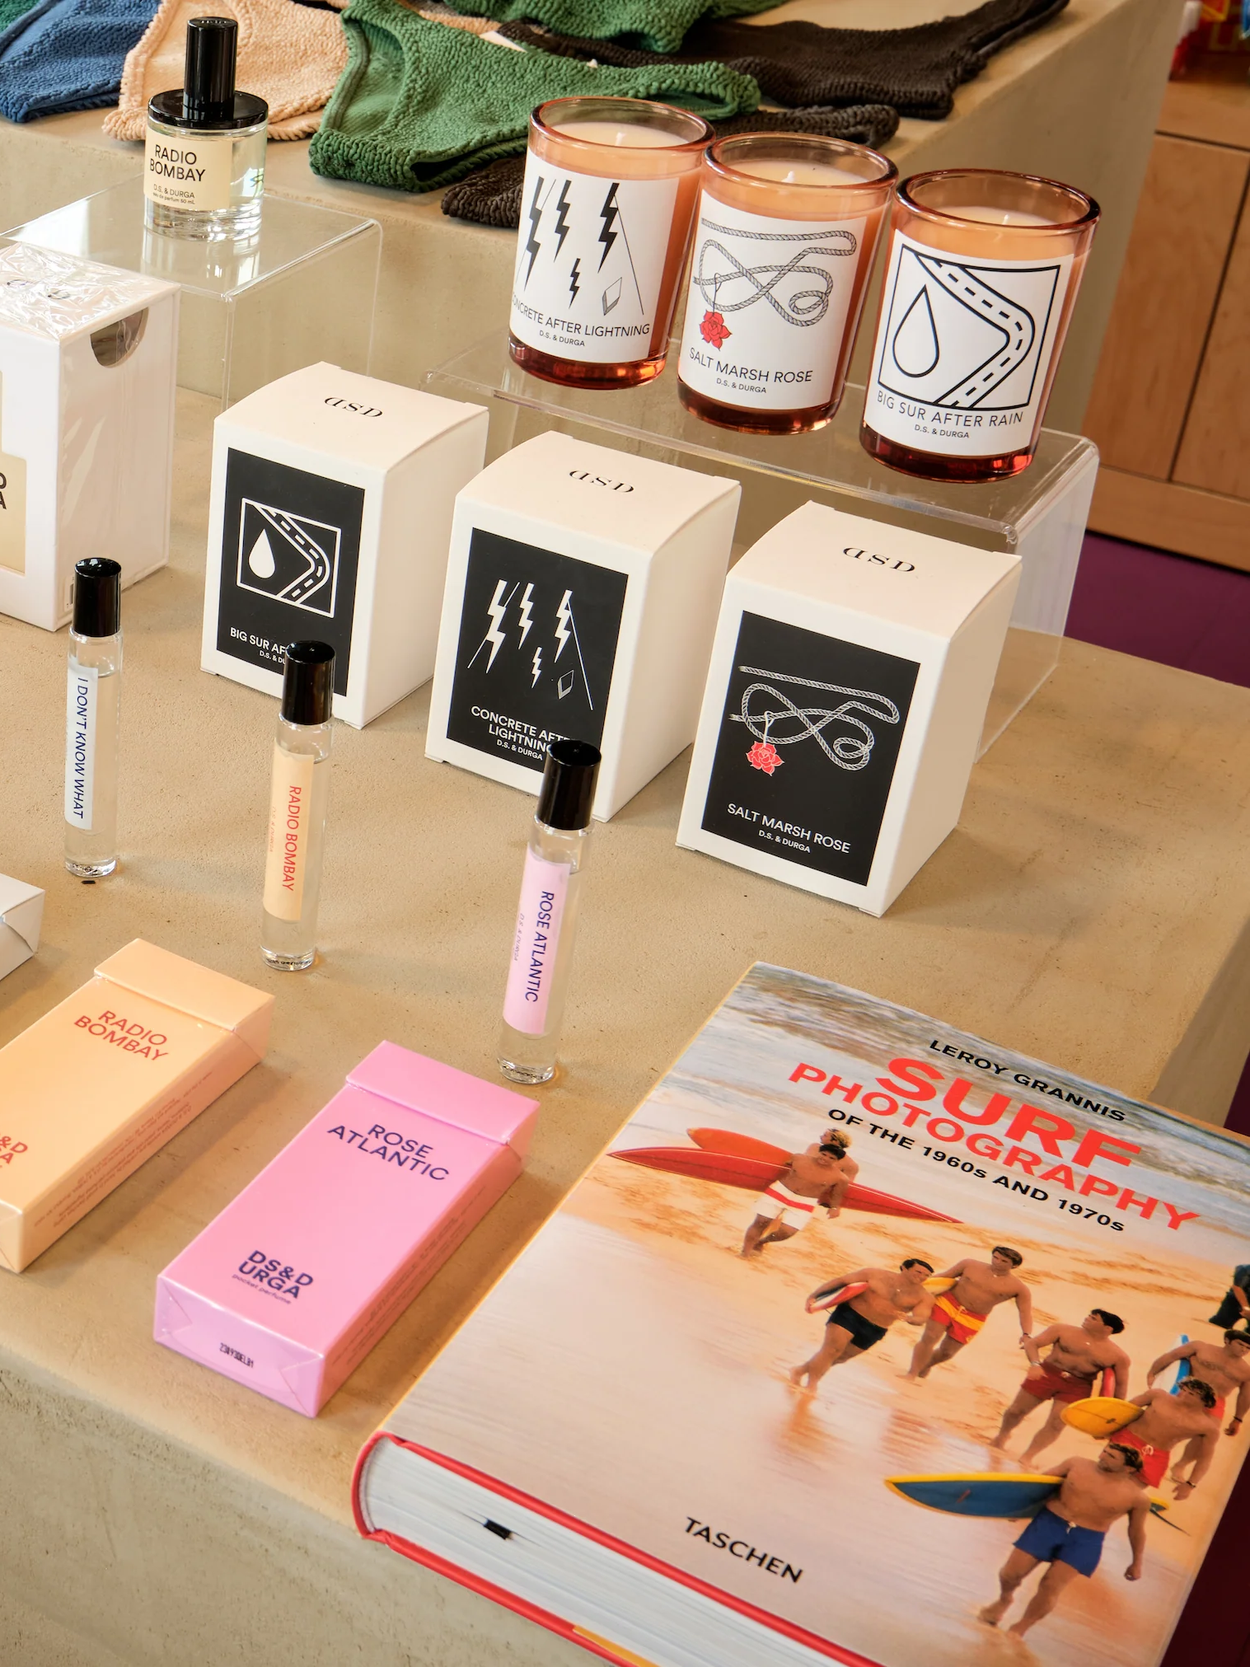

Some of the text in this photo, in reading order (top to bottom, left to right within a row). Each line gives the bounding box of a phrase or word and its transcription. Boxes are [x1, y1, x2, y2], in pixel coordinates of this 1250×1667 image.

[150, 159, 206, 182] BOMBAY
[155, 145, 196, 165] RADIO
[153, 184, 163, 194] D.S.
[170, 189, 195, 199] DURGA
[164, 194, 179, 202] parfum
[513, 292, 650, 337] ONCRETE AFTER LIGHTNING
[540, 330, 551, 339] D.S.
[559, 336, 585, 346] DURGA
[689, 347, 813, 383] SALT MARSH ROSE
[716, 378, 729, 387] D.S.
[739, 384, 767, 393] DURGA
[877, 390, 1024, 427] BIG SUR AFTER RAIN
[914, 424, 929, 433] D.S.
[940, 429, 969, 438] DURGA
[230, 627, 248, 642] BIG
[250, 634, 270, 650] SUR
[260, 650, 271, 659] D.S.
[76, 685, 88, 729] DON'T
[471, 706, 537, 737] CONCRETE
[74, 731, 87, 776] KNOW
[497, 739, 510, 749] D.S.
[518, 747, 543, 761] DURGA
[73, 779, 84, 819] WHAT
[282, 786, 302, 891] RADIO BOMBAY
[727, 803, 851, 854] SALT MARSH ROSE
[758, 830, 811, 853] D.S. & DURGA
[525, 891, 554, 1003] ROSE ATLANTIC
[74, 1015, 169, 1061] BOMBAY
[98, 1010, 167, 1046] RADIO
[929, 1039, 1127, 1122] LEROY GRANNIS
[876, 1057, 1142, 1169] SURF
[327, 1125, 449, 1180] ATLANTIC
[367, 1124, 434, 1159] ROSE
[788, 1062, 1200, 1231] PHOTOGRAPHY
[827, 1108, 1125, 1232] OF THE 1960s AND 1970s
[238, 1261, 300, 1299] URGA
[248, 1250, 314, 1286] DS&D
[232, 1274, 291, 1304] pocket perfume
[684, 1516, 803, 1583] TASCHEN
